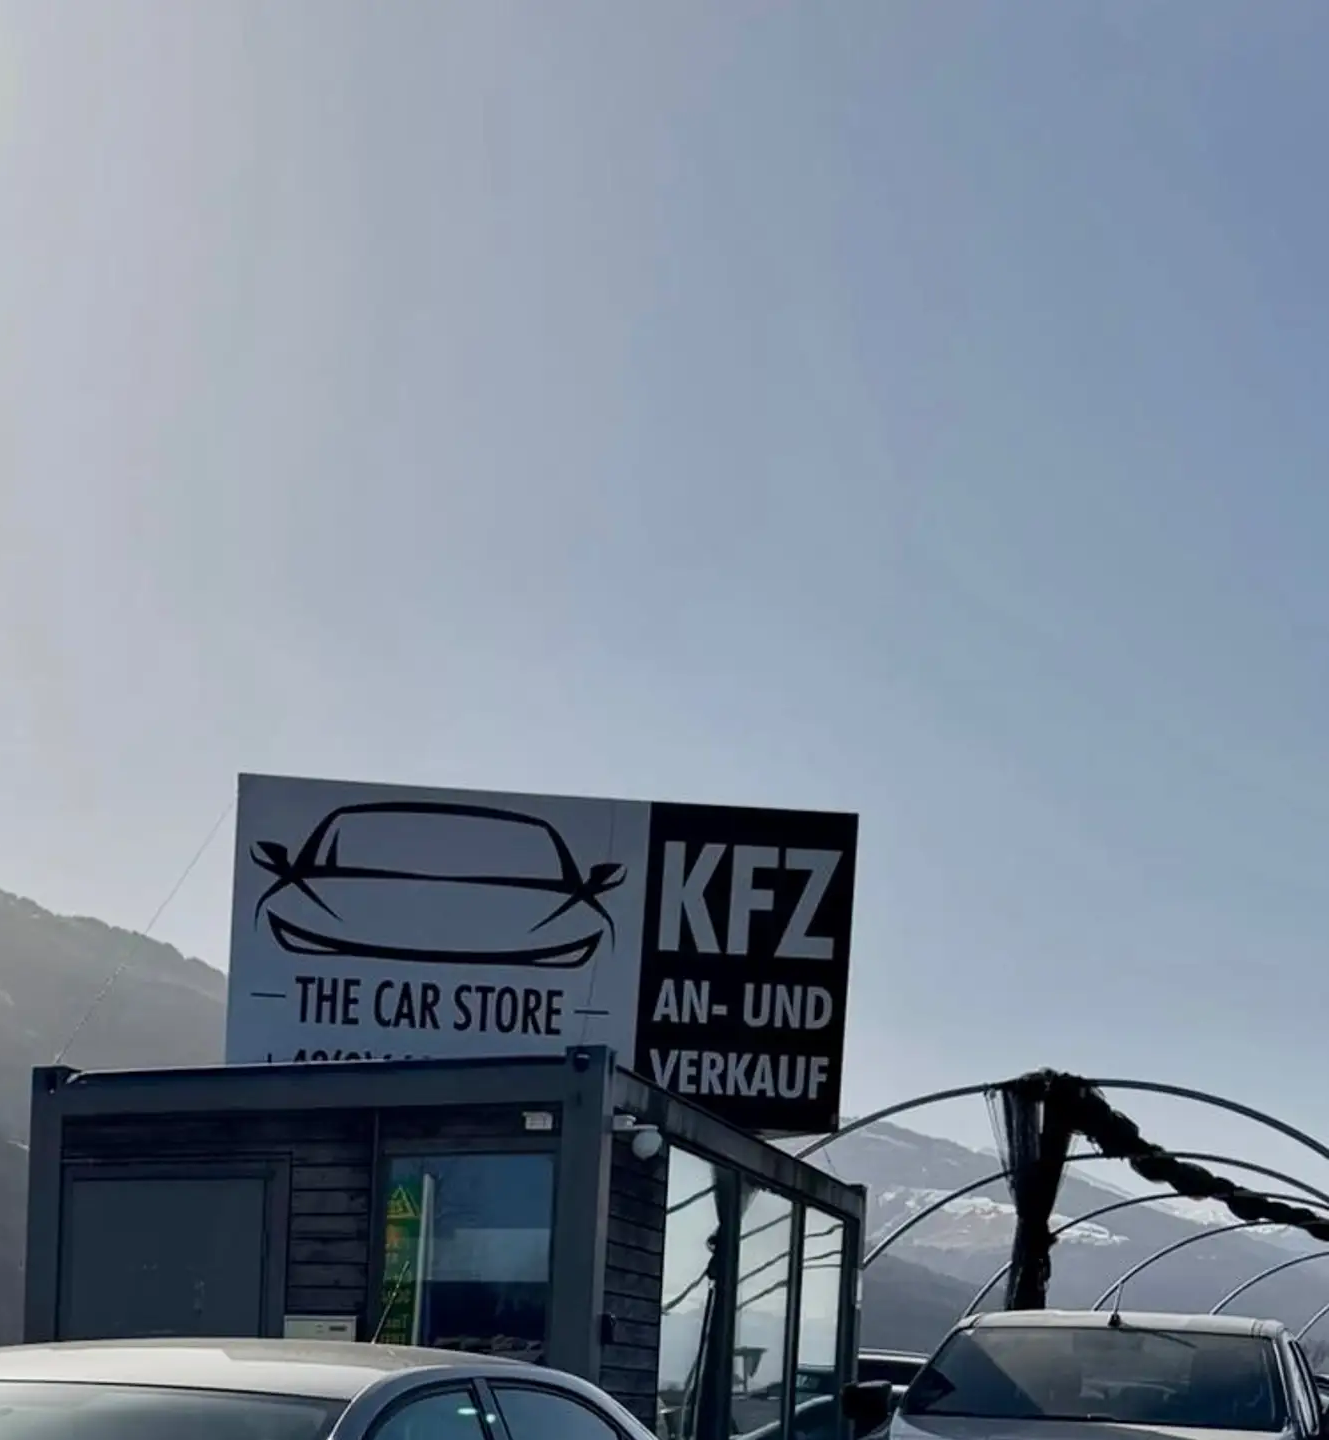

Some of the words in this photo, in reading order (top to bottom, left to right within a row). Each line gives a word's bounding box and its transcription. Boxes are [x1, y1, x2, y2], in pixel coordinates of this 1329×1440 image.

[658, 840, 843, 960] KFZ
[294, 976, 360, 1026] THE
[373, 979, 440, 1030] CAR
[453, 984, 563, 1036] STORE
[652, 978, 729, 1025] AN-
[743, 983, 833, 1031] UND
[650, 1048, 830, 1101] VERKAUF
